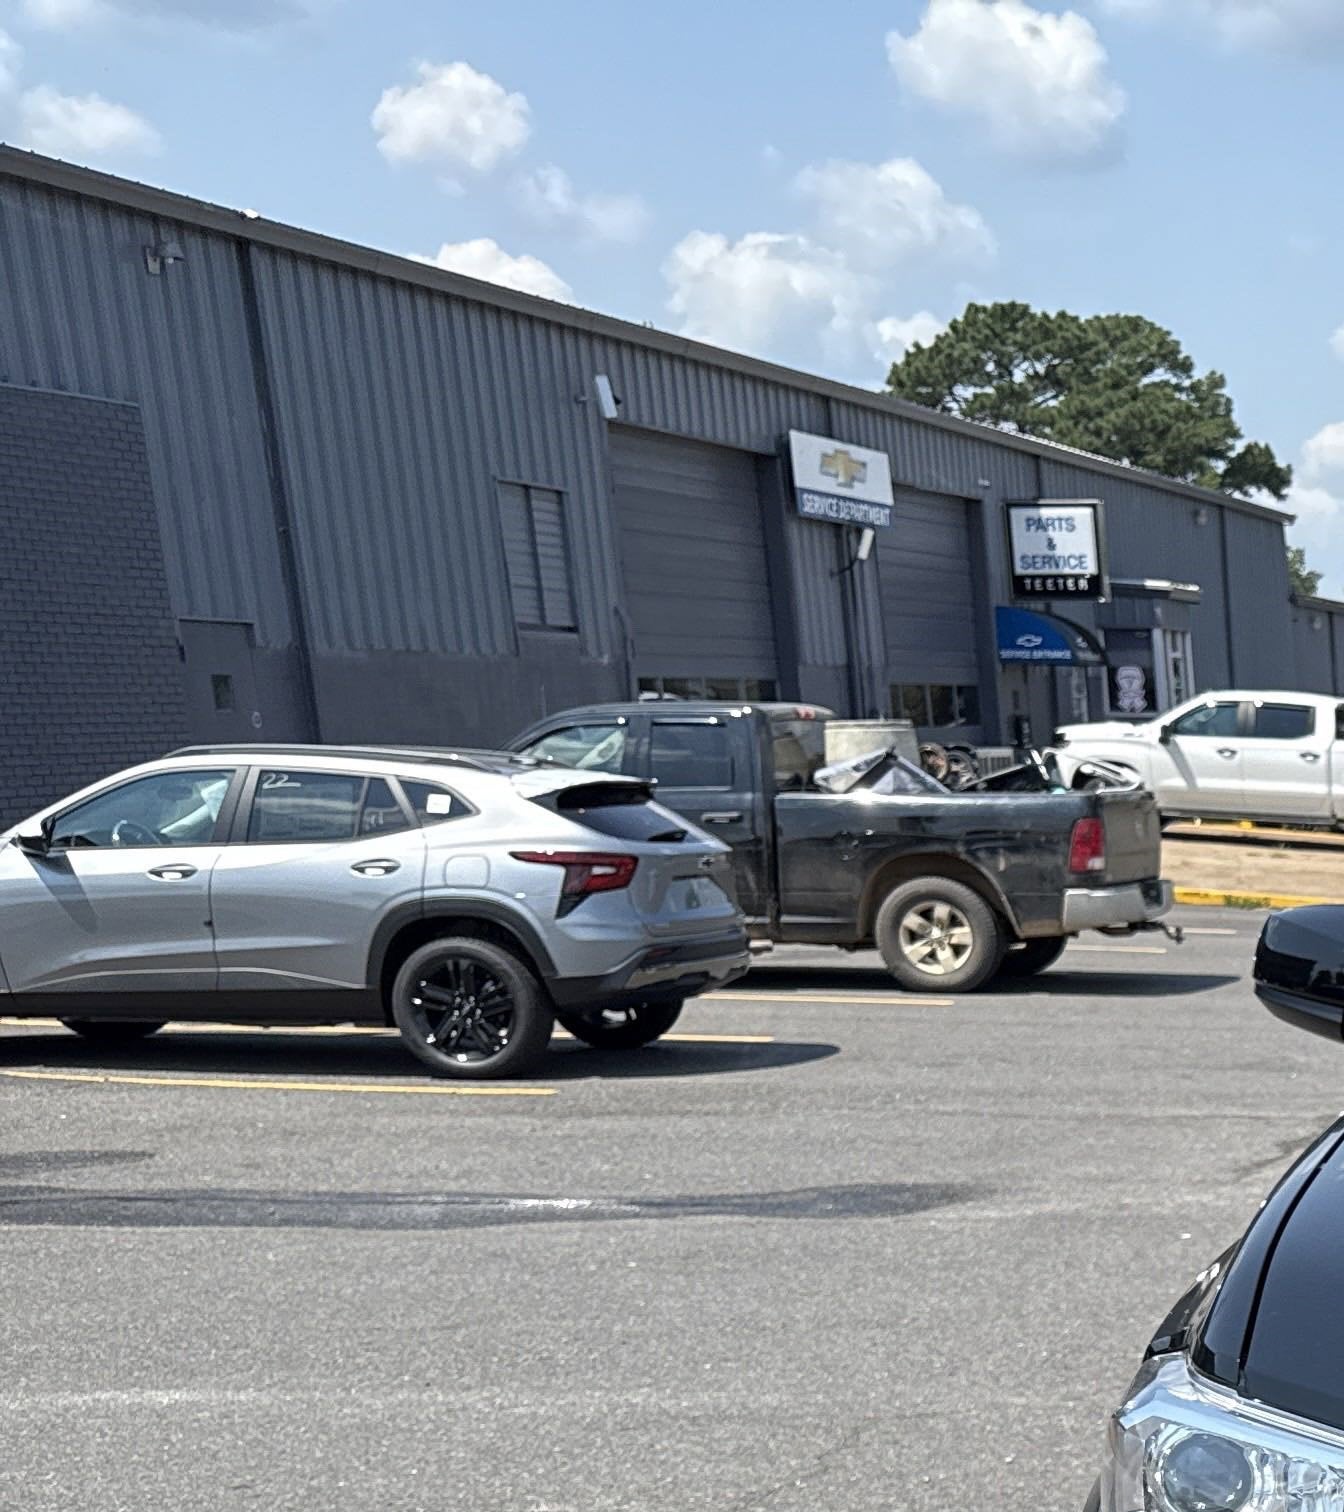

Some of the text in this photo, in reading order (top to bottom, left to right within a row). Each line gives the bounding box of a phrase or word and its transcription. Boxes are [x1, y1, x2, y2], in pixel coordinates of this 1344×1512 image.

[802, 493, 890, 526] SERVICE DEPARTMENT
[1024, 516, 1076, 532] PARTS
[1046, 538, 1056, 551] &
[1020, 554, 1088, 570] SERVICE
[1024, 577, 1088, 591] TEETER
